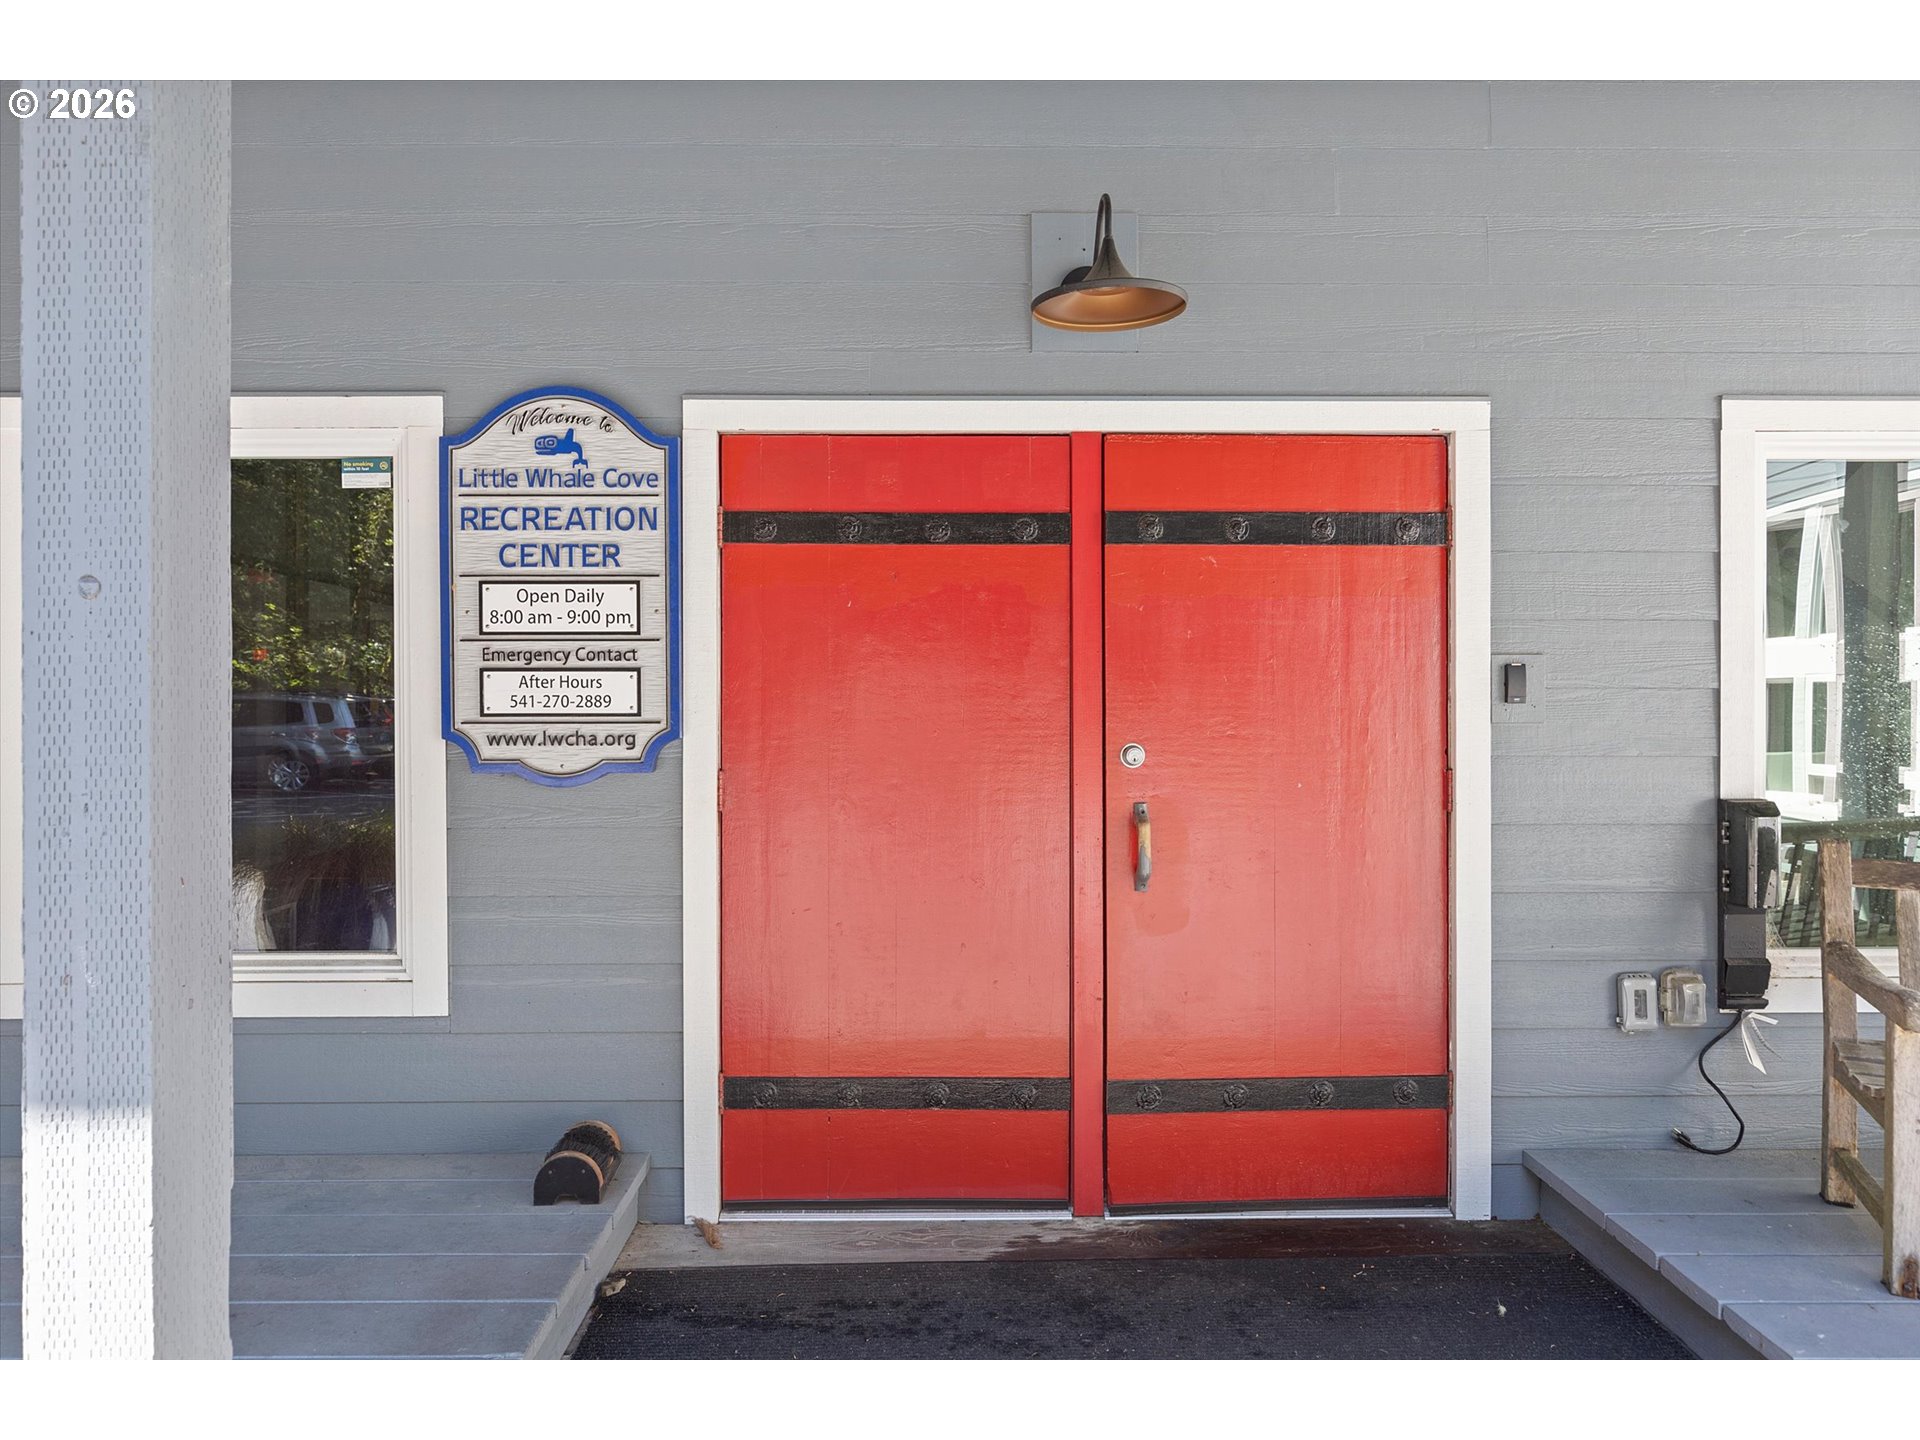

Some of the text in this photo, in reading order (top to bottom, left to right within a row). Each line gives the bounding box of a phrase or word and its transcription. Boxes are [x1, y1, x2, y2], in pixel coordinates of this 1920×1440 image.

[505, 407, 614, 435] Welcome to
[458, 468, 659, 488] Little Whale Cove
[459, 507, 658, 531] RECREATION
[499, 543, 621, 568] CENTER
[516, 588, 605, 607] Open Daily
[489, 610, 523, 624] 8:00
[527, 613, 552, 624] am
[567, 610, 601, 624] 9:00
[605, 613, 631, 628] pm
[482, 647, 638, 665] Emergency Contact
[518, 675, 603, 689] After Hours
[510, 694, 612, 708] 541-270-2889
[486, 730, 636, 750] www.lwcha.org
